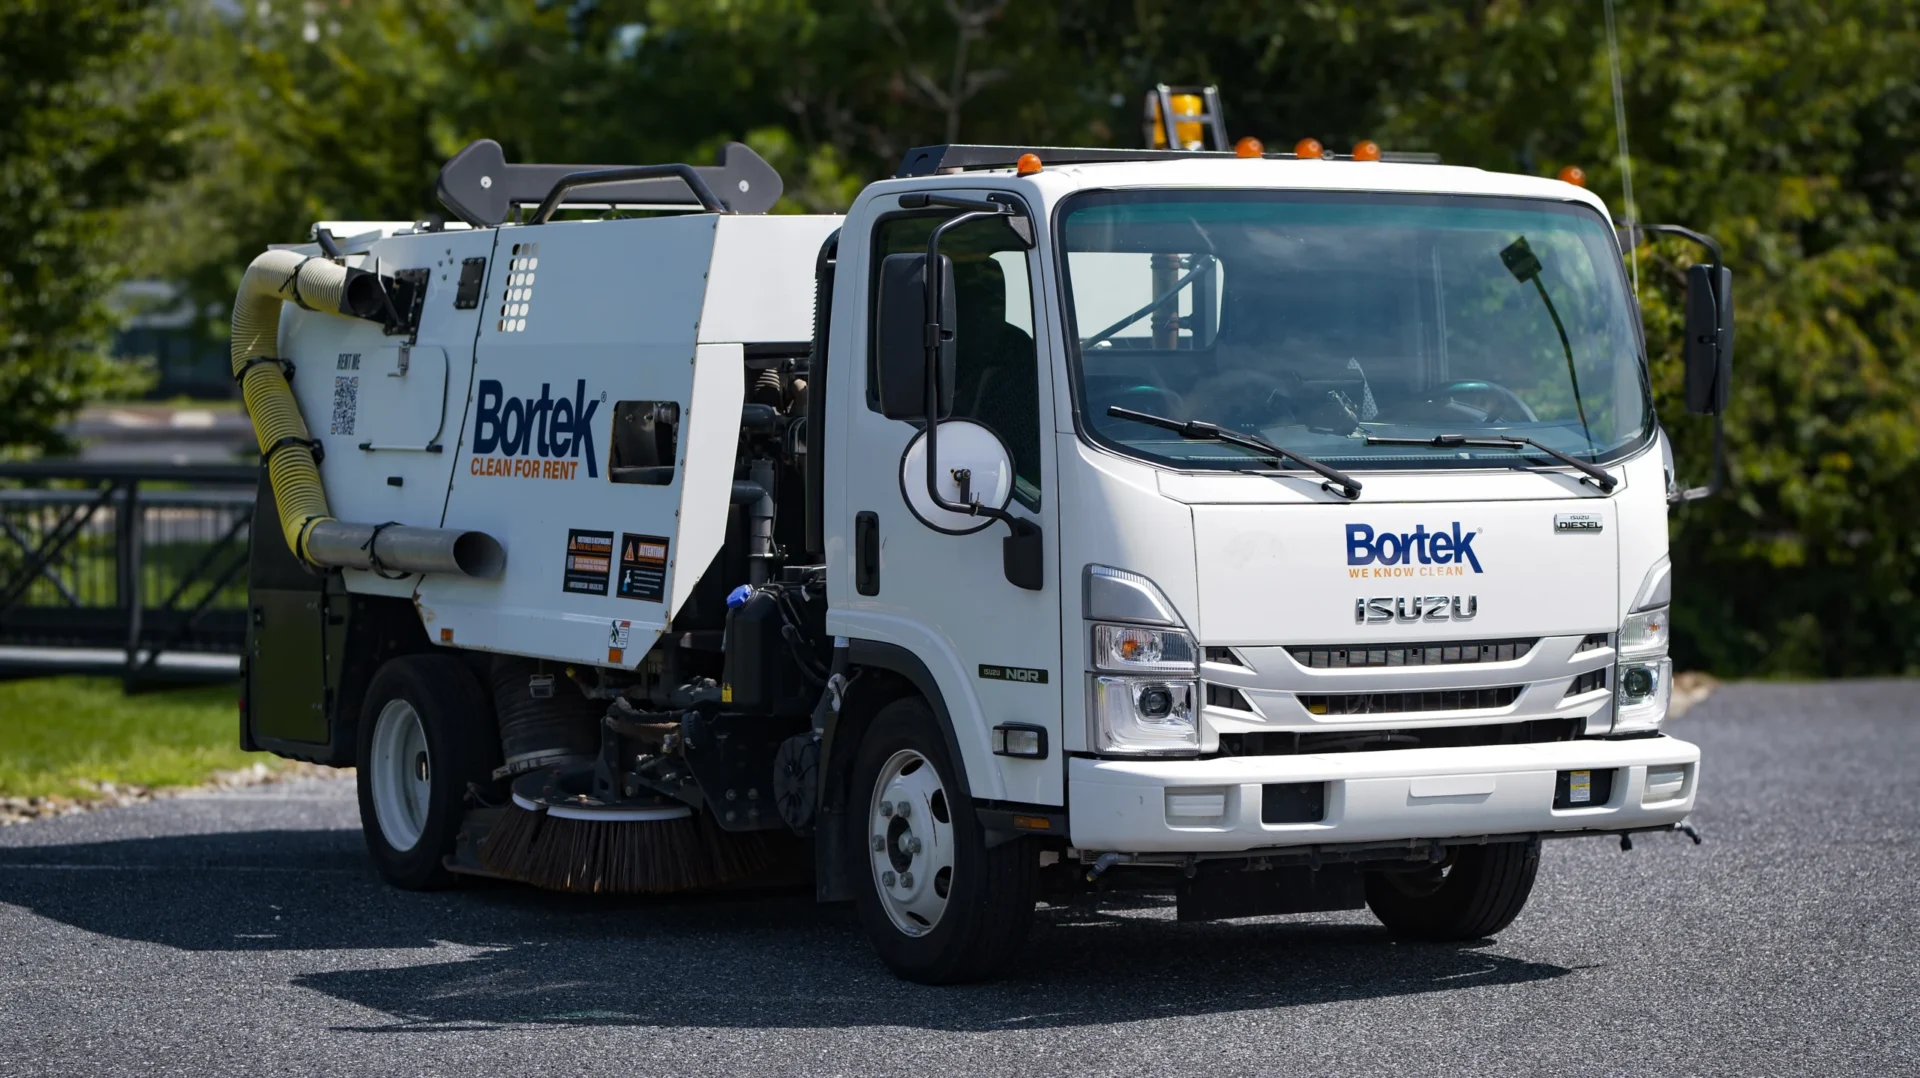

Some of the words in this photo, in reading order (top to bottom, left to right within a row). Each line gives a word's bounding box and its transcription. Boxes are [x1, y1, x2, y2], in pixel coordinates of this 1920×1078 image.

[336, 353, 352, 370] RENT
[351, 353, 361, 370] ME
[472, 378, 600, 478] Bortek
[470, 457, 512, 477] CLEAN
[514, 459, 541, 478] FOR
[542, 460, 578, 480] RENT
[1559, 521, 1602, 529] DIESEL
[639, 544, 665, 558] ATTENTION
[1345, 521, 1484, 574] Bortek
[1348, 568, 1369, 578] WE
[1373, 567, 1415, 578] KNOW
[1419, 566, 1464, 577] CLEAN
[1355, 594, 1478, 624] ISUZU
[983, 668, 1001, 676] ISUZU
[1005, 668, 1039, 682] NQR
